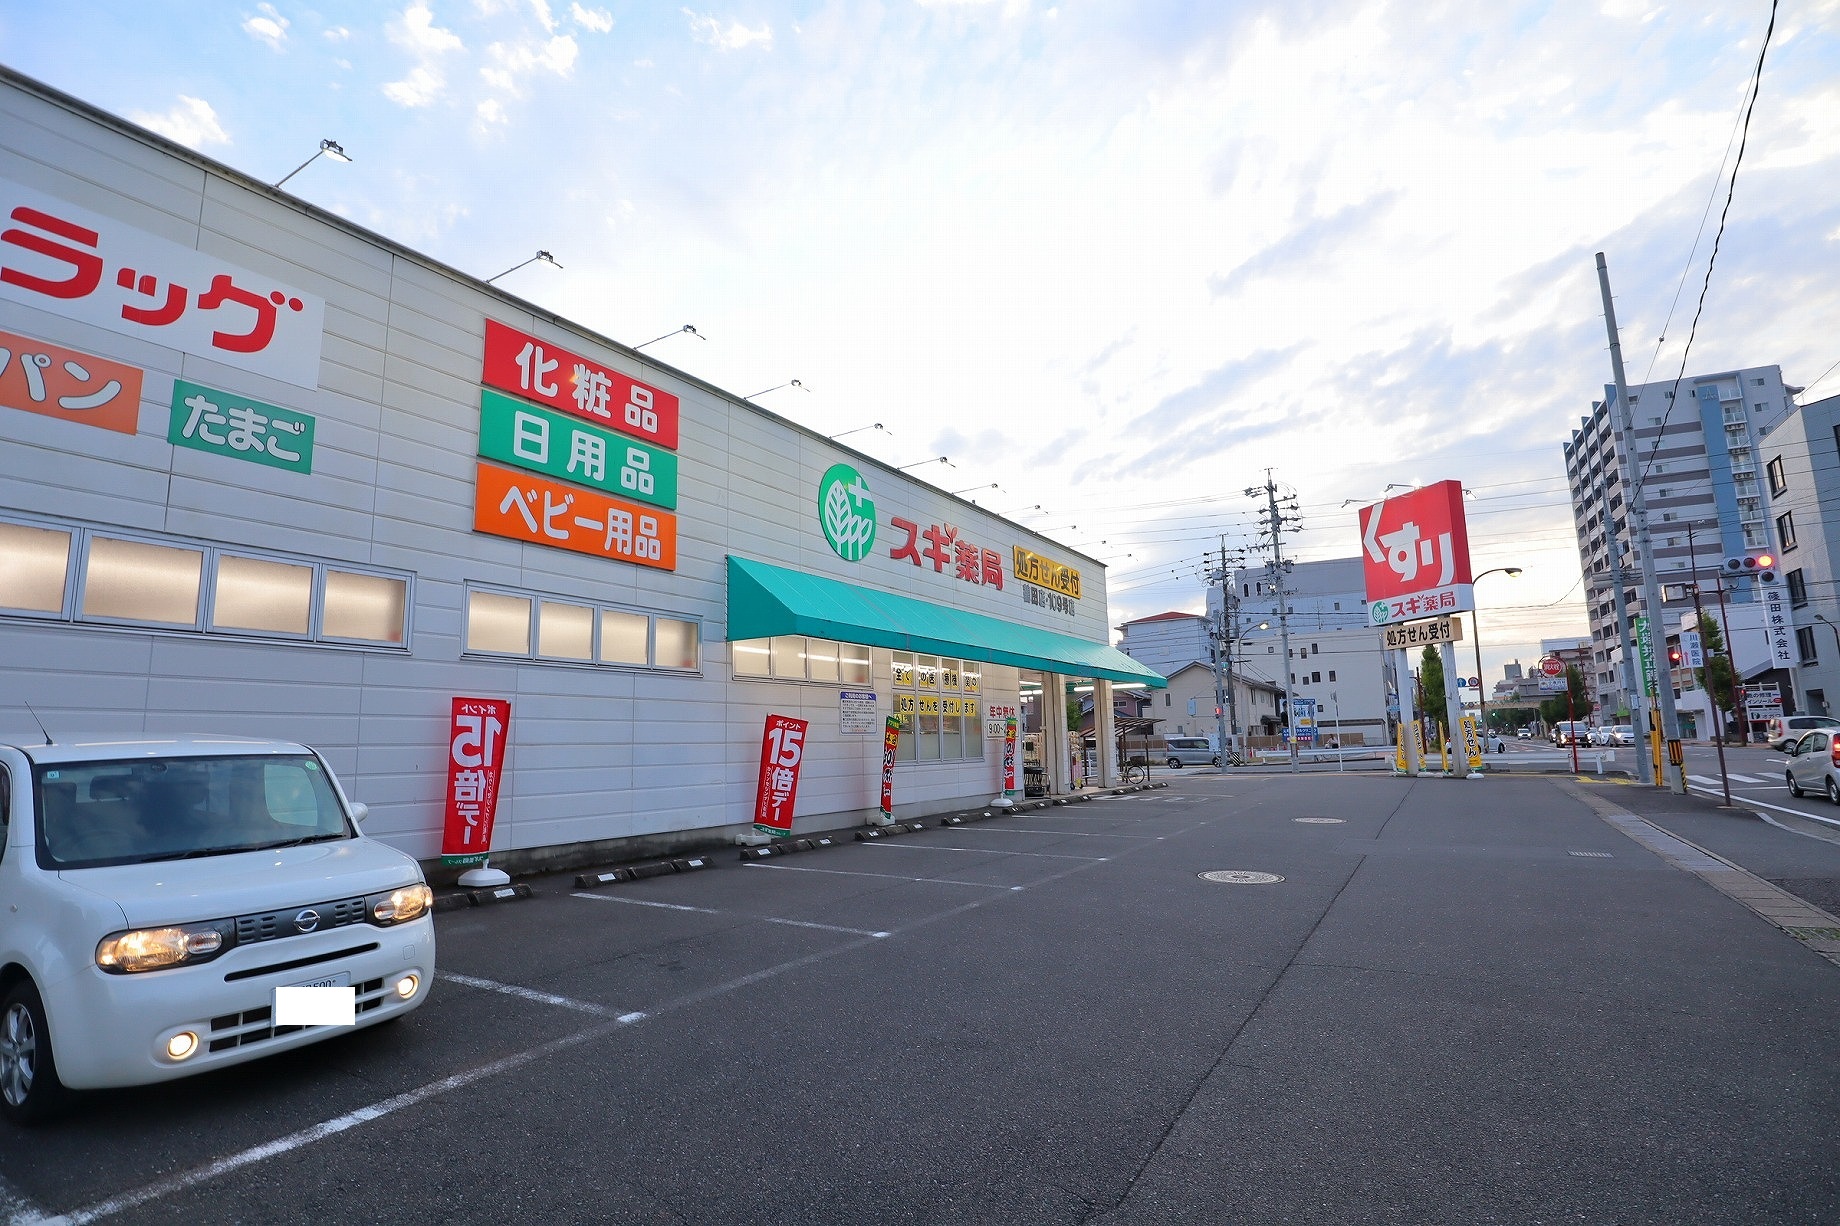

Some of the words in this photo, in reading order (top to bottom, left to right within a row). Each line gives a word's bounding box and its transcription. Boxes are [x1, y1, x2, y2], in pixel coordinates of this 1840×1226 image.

[1, 206, 304, 353] ラッグ
[0, 347, 122, 410] パン
[515, 341, 658, 434] 化粧品
[182, 394, 306, 462] たまご
[513, 410, 654, 496] 日用品
[499, 485, 661, 561] ベビー用品
[1363, 503, 1456, 587] くすり
[890, 516, 1003, 590] スギ薬局
[1015, 549, 1081, 596] 処方せん受付
[1386, 621, 1450, 646] 処方せん受付
[1391, 591, 1456, 618] スギ薬局
[1767, 591, 1791, 661] 篠田株式会社
[775, 719, 801, 730] ポイント
[901, 698, 975, 713] 処方せんを受付します
[989, 706, 1016, 718] 年中無休
[768, 728, 803, 768] 15
[1463, 720, 1478, 758] 処方せん
[771, 767, 795, 821] 倍デー
